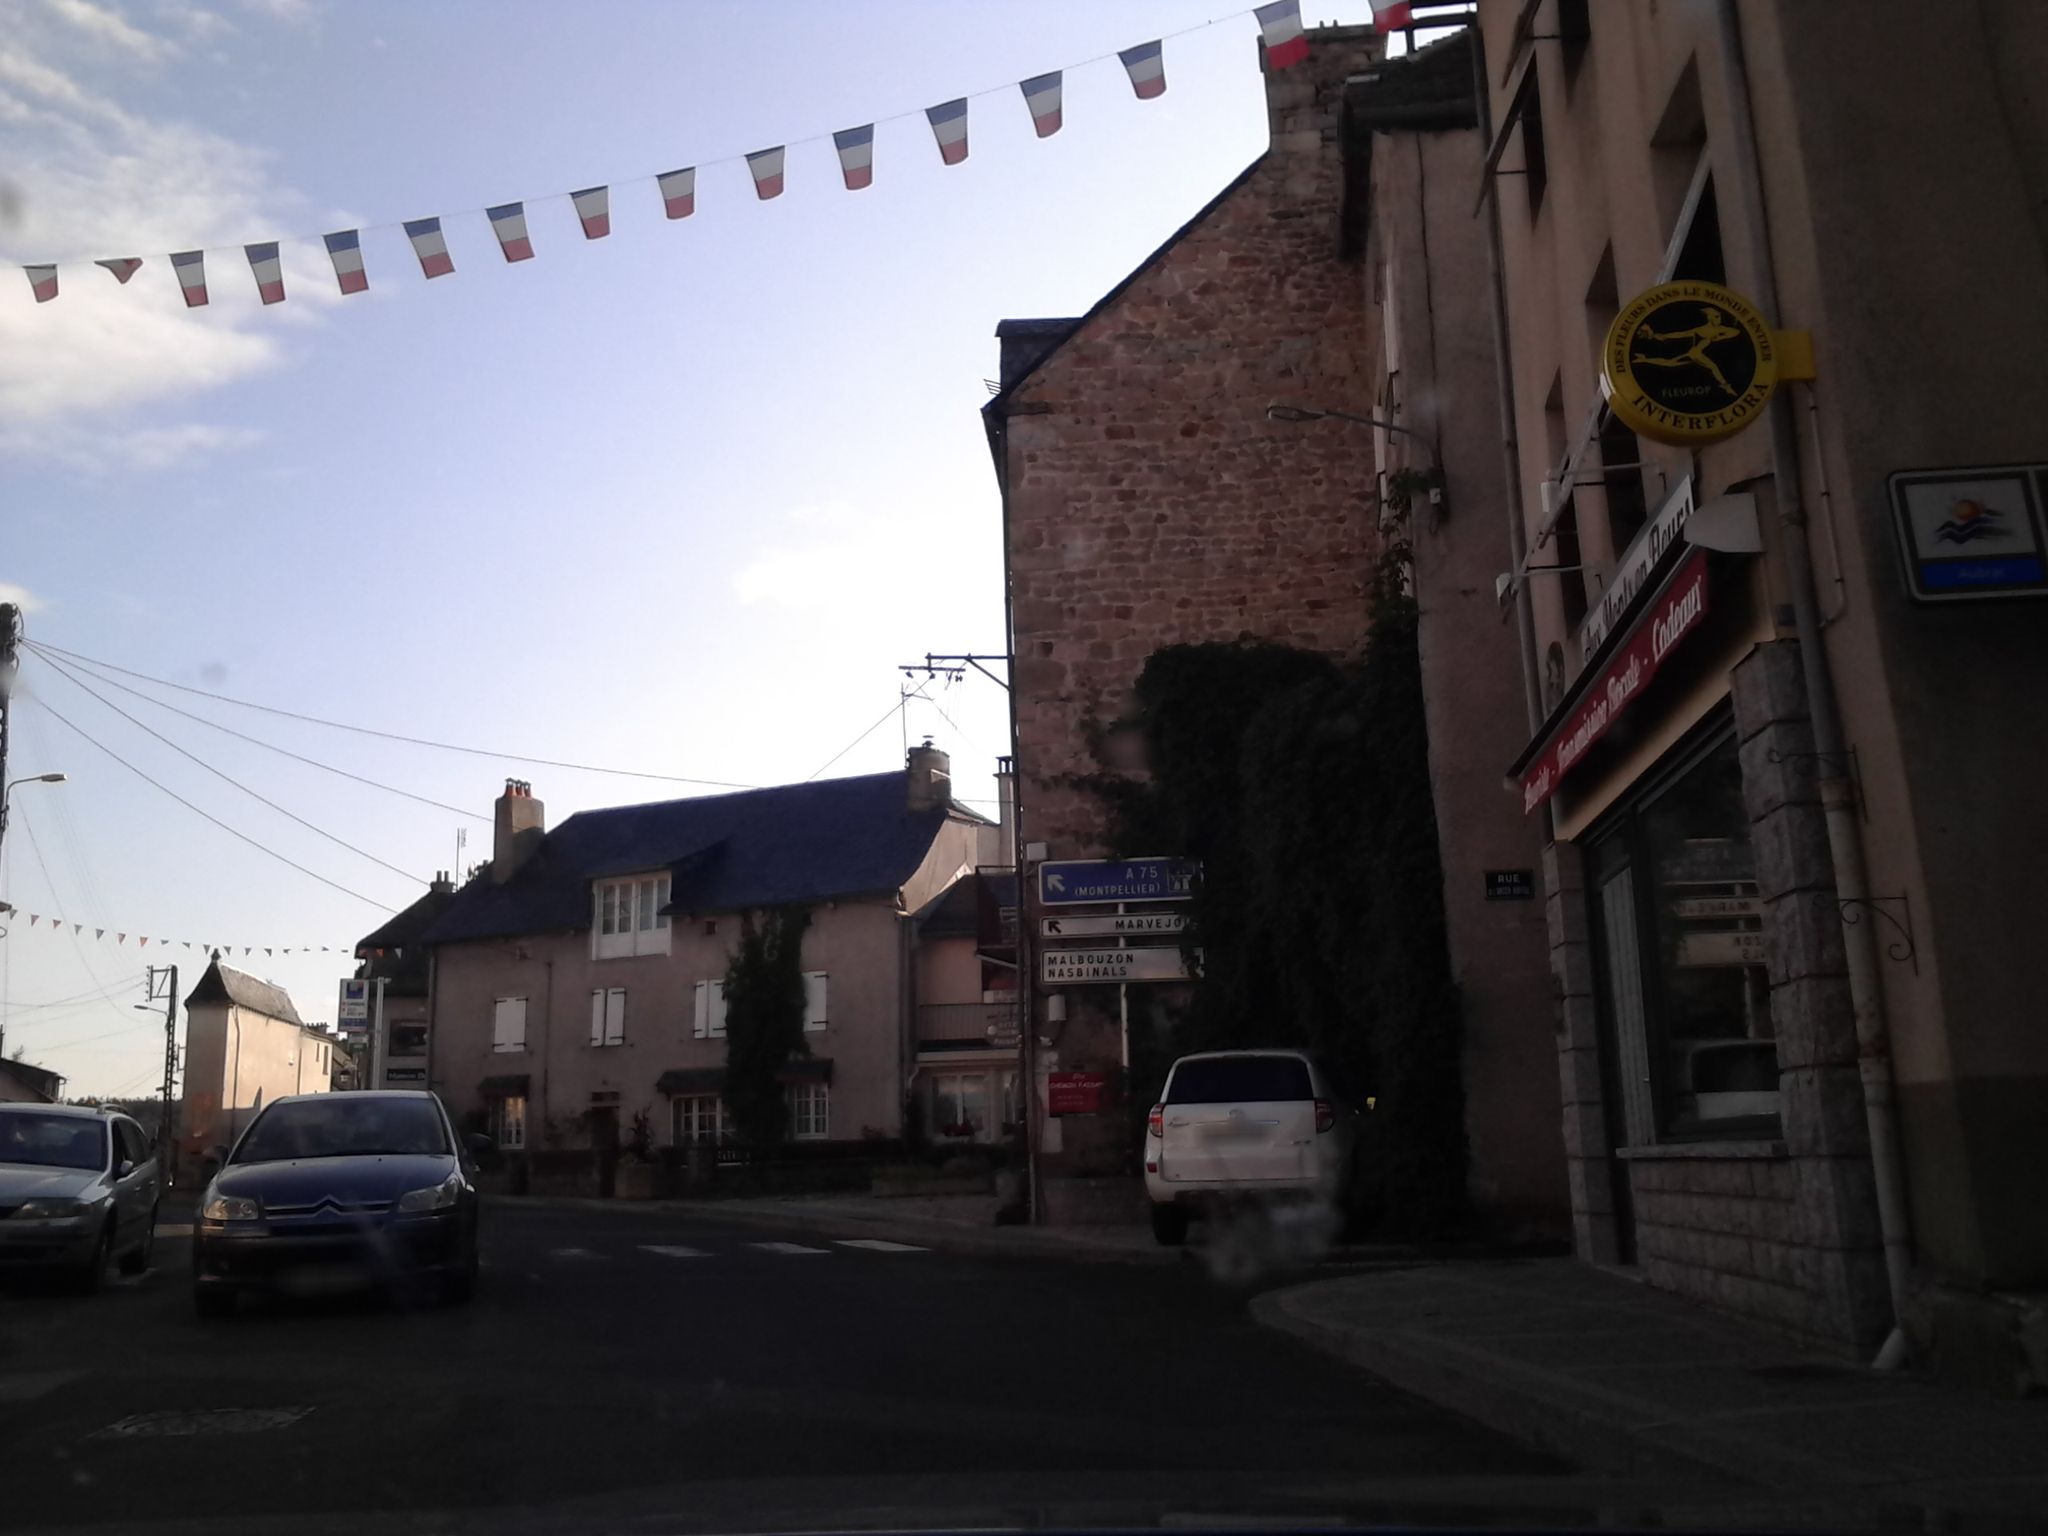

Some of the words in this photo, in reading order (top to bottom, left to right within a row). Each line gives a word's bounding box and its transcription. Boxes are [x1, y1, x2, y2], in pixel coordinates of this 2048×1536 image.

[1646, 287, 1680, 307] DANS
[1683, 287, 1702, 297] LE
[1704, 288, 1749, 318] MONDE
[1615, 304, 1648, 346] FLEURS
[1747, 317, 1772, 362] ENTIER
[1615, 345, 1627, 374] DES
[1632, 383, 1769, 430] INTERFLORA
[1126, 867, 1134, 880] A
[1140, 866, 1158, 879] 75
[1497, 874, 1520, 883] RUE
[1074, 883, 1161, 896] (MONTPELLIER)
[1115, 917, 1199, 930] MARVEJO
[1048, 954, 1134, 966] MALBOUZON
[1048, 967, 1127, 978] NASBINALS
